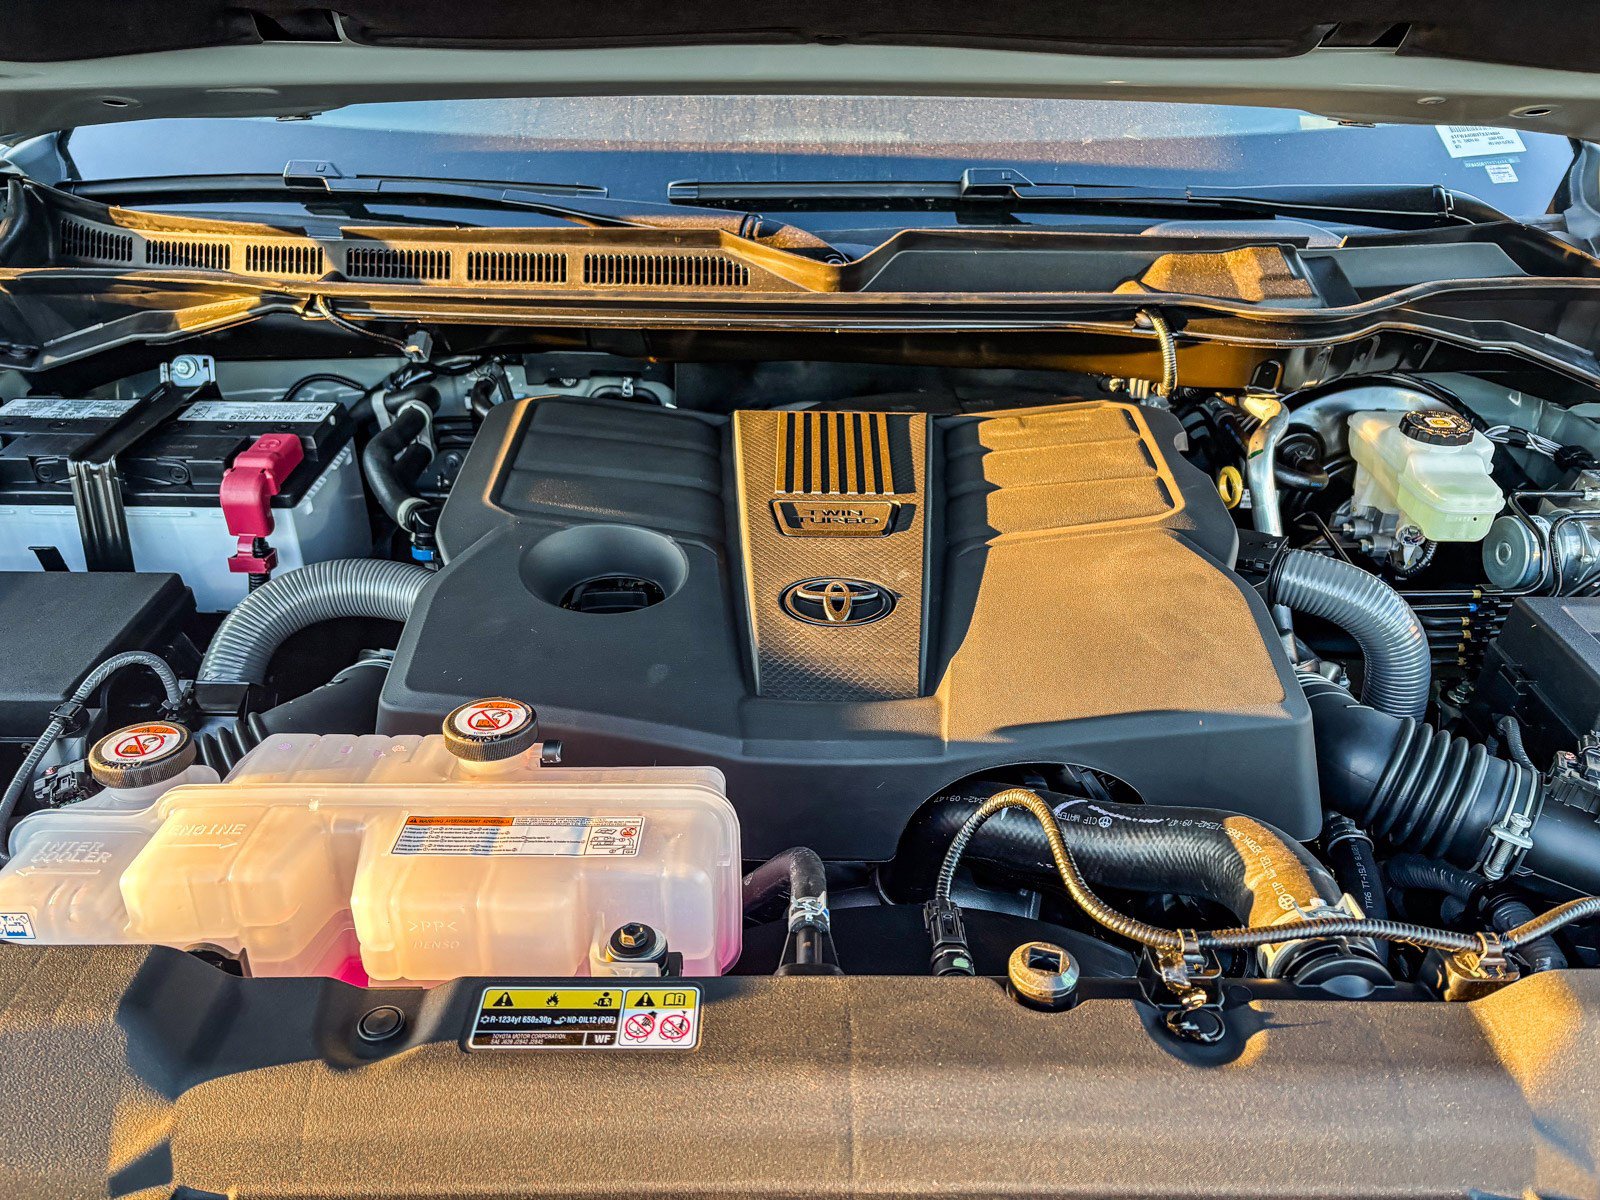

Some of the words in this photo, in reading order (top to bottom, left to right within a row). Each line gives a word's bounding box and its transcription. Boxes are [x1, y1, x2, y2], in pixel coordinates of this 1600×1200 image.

[799, 516, 880, 524] TURBO
[170, 823, 247, 835] ENGINE
[40, 841, 105, 852] INTER
[31, 852, 112, 863] COOLER
[594, 1034, 611, 1044] WF
